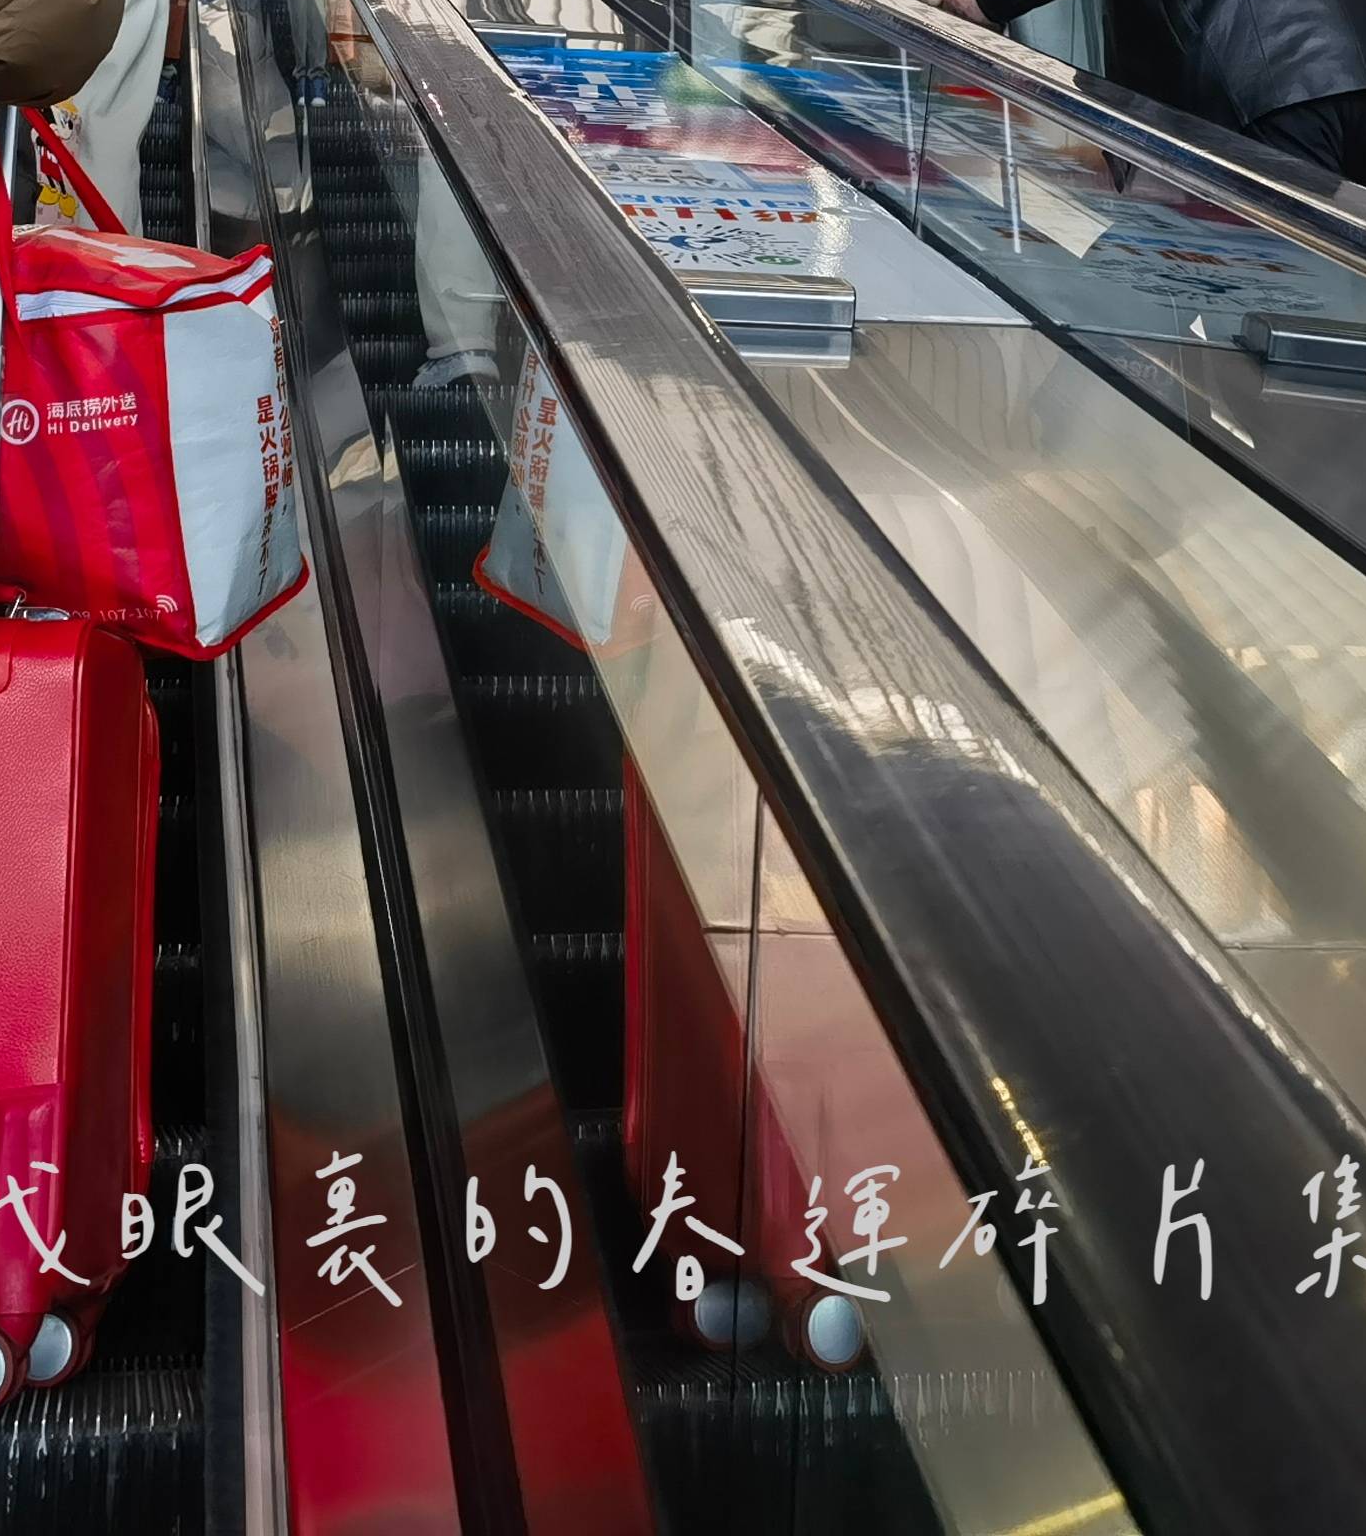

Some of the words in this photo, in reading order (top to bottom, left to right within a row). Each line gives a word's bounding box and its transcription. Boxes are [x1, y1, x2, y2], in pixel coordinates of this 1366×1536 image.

[46, 391, 138, 421] 海底捞外送
[47, 421, 64, 436] Hi
[69, 414, 139, 433] Delivery
